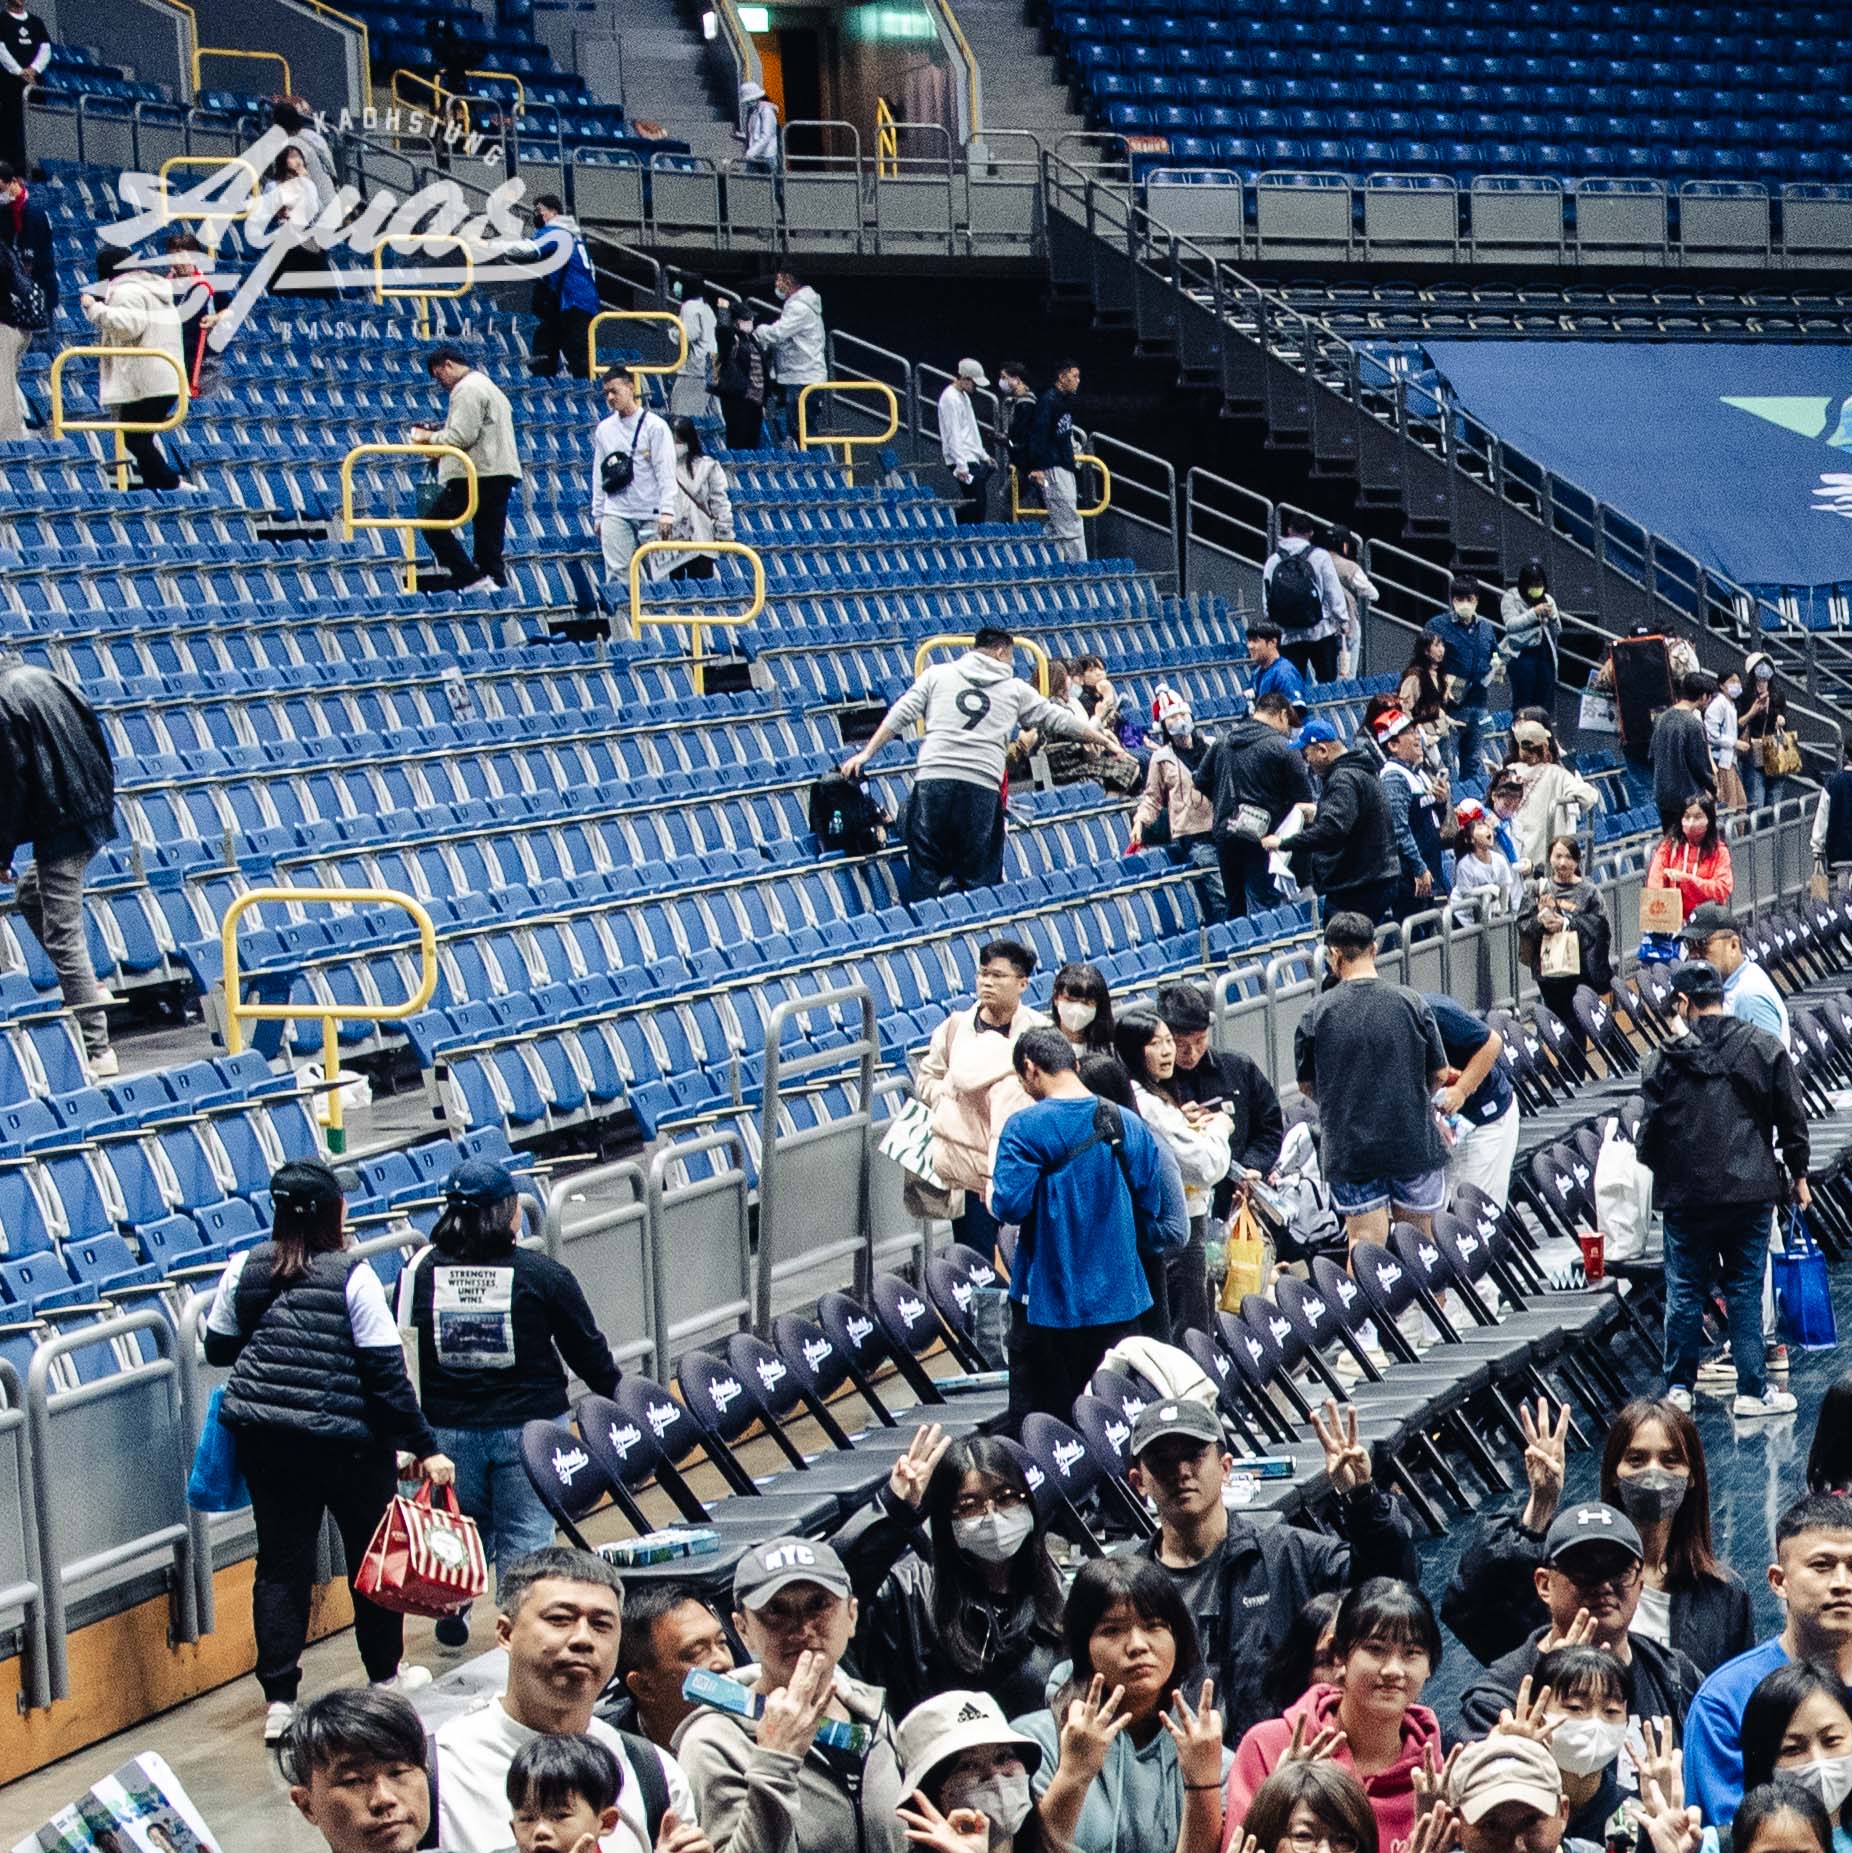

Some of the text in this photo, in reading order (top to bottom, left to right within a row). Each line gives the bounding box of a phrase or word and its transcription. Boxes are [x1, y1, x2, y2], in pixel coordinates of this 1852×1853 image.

[953, 691, 990, 733] 9
[449, 1269, 497, 1278] STRENGTH
[765, 1543, 816, 1572] NYC
